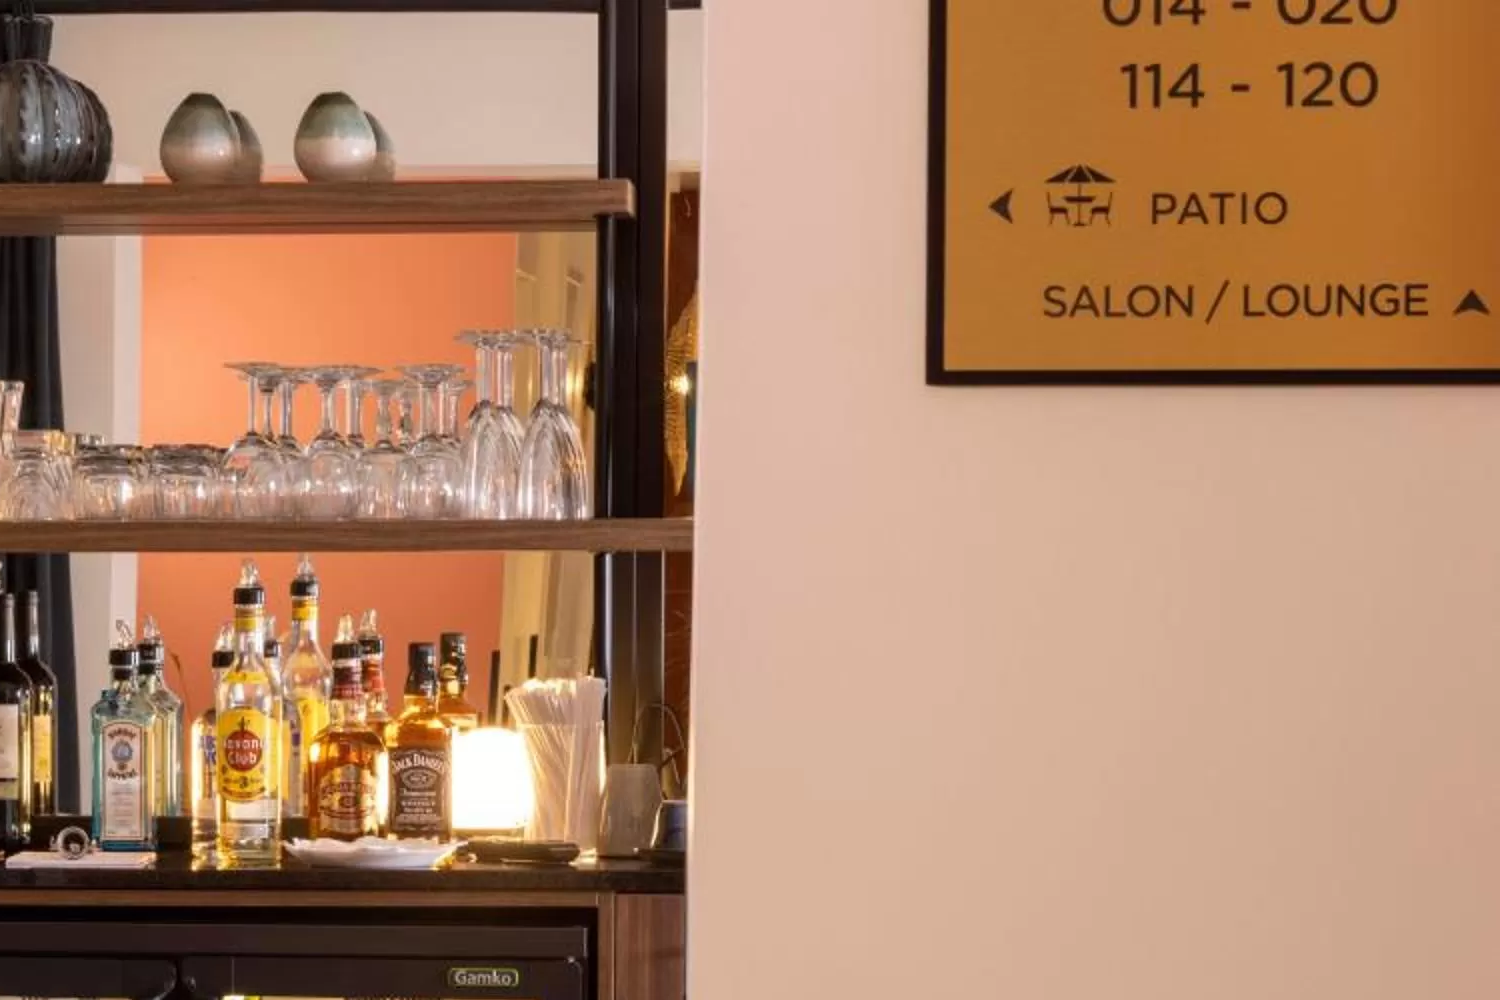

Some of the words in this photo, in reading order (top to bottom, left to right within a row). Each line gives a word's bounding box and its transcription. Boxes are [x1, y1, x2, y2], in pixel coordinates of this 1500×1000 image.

[1103, 0, 1207, 26] 014
[1277, 0, 1397, 26] 020
[1120, 62, 1206, 109] 114
[1277, 61, 1380, 108] 120
[1151, 191, 1289, 226] PATIO
[1043, 283, 1195, 319] SALON
[1242, 282, 1430, 318] LOUNGE
[455, 969, 512, 986] Gamko
